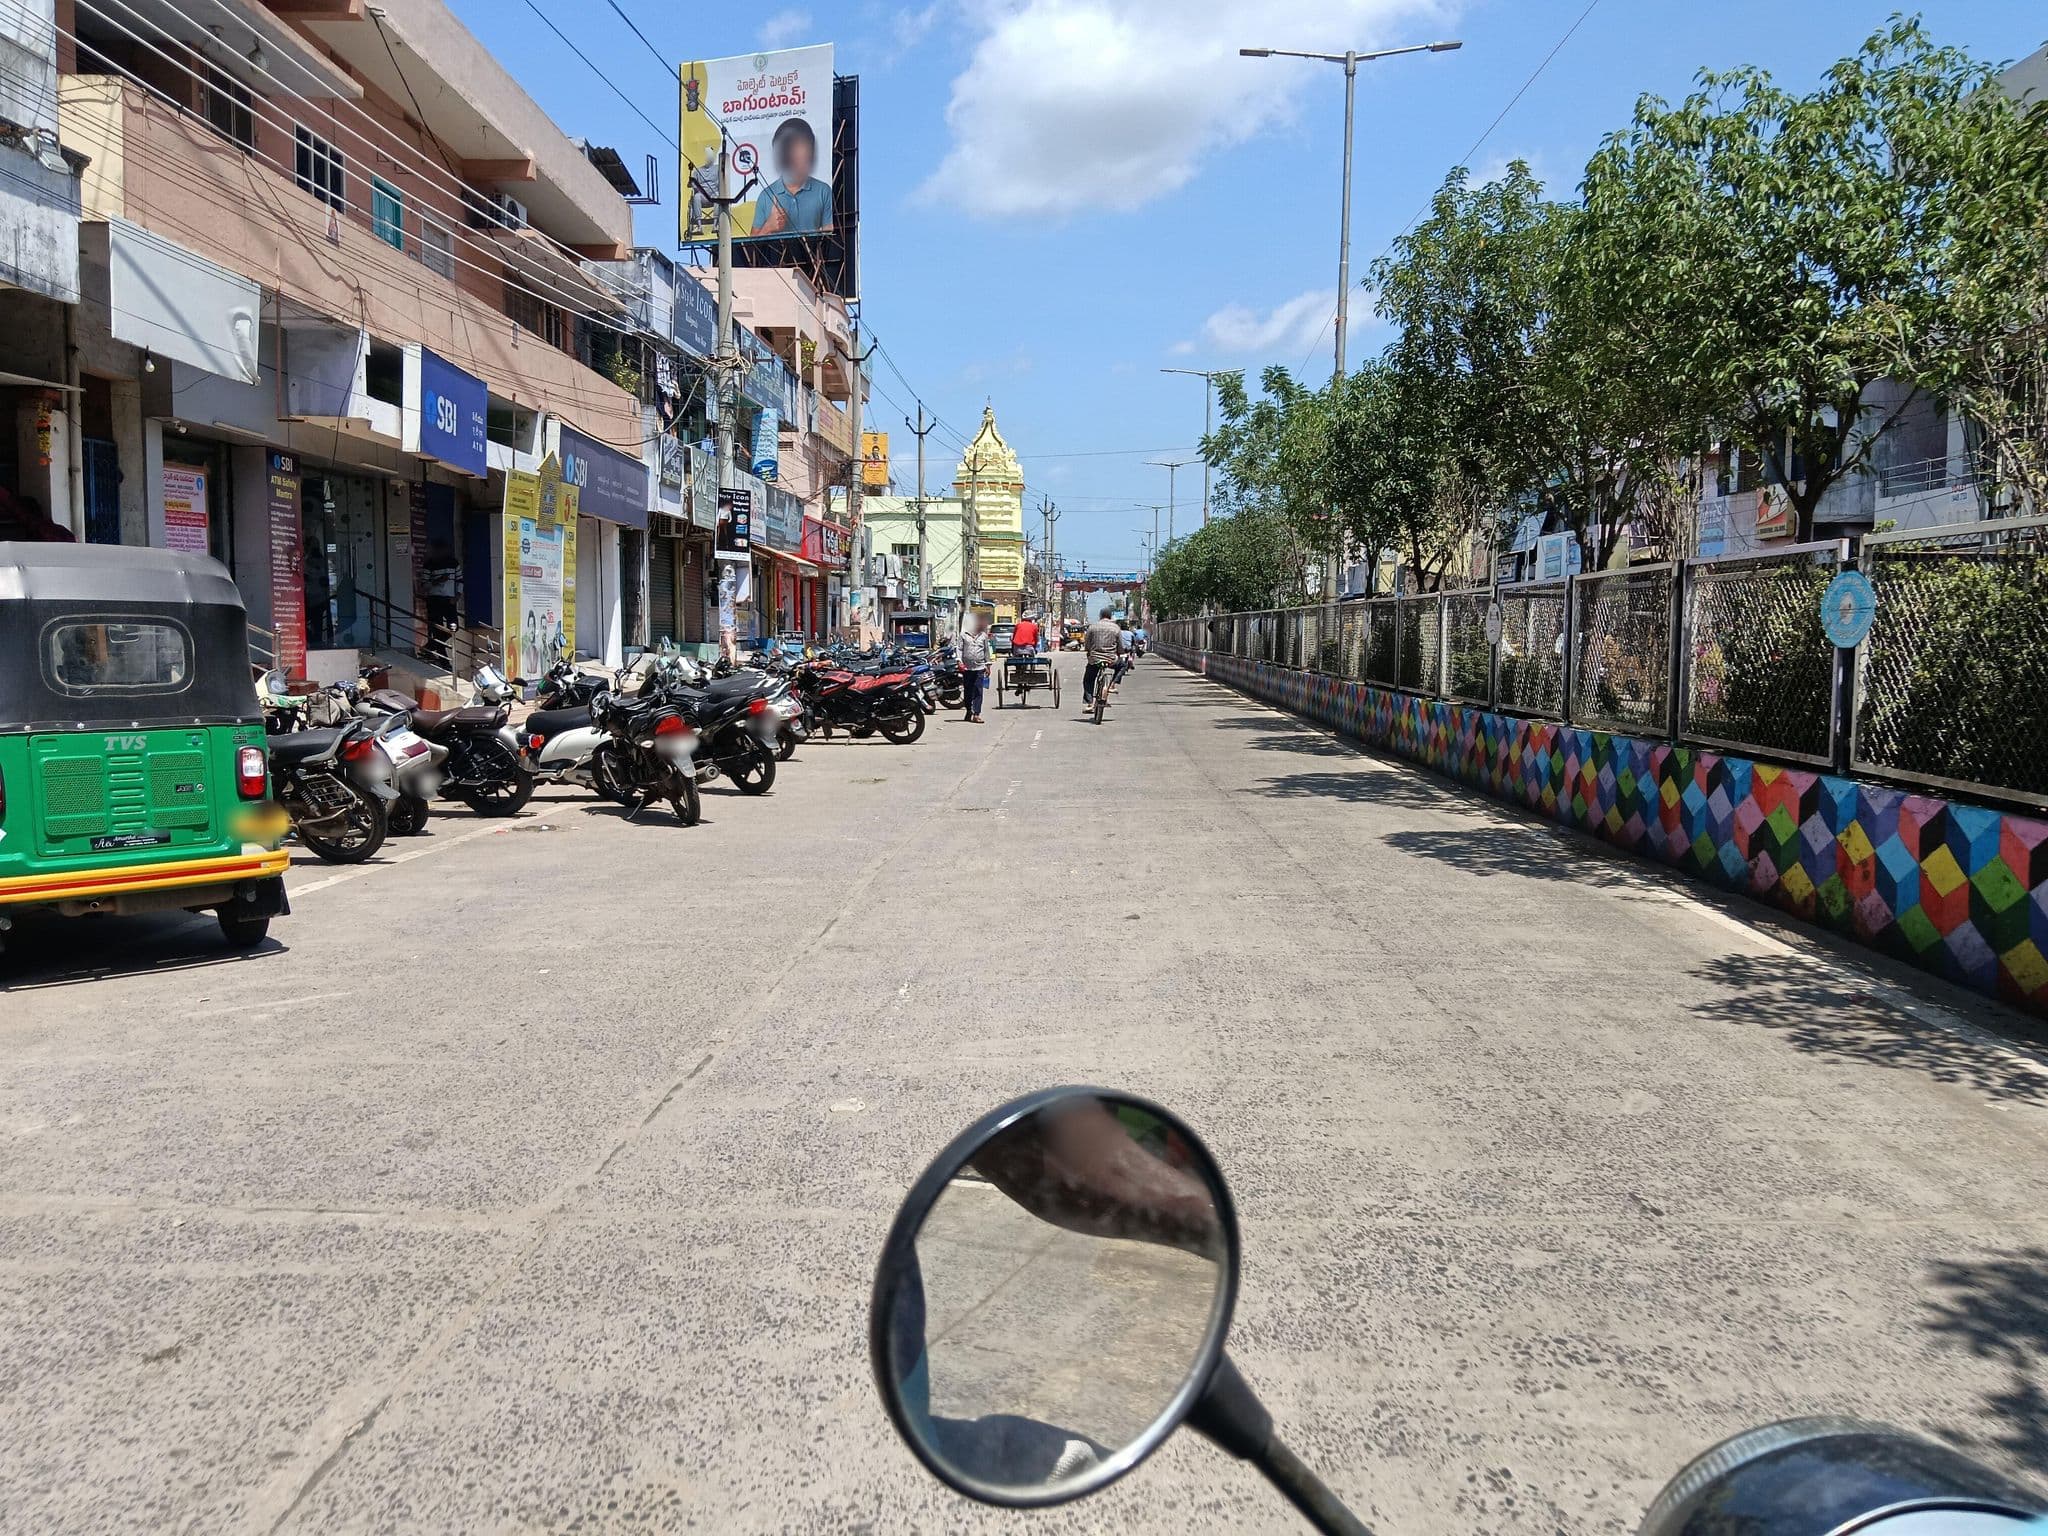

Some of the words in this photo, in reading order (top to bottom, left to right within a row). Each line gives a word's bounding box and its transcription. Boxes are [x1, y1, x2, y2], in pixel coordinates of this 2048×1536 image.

[723, 86, 806, 113] బాగుంటావ్!
[696, 286, 713, 322] Icon
[437, 395, 457, 436] SBI
[281, 456, 293, 472] SBI
[574, 456, 588, 488] SBI
[733, 493, 749, 501] Icon
[104, 735, 147, 751] TVS
